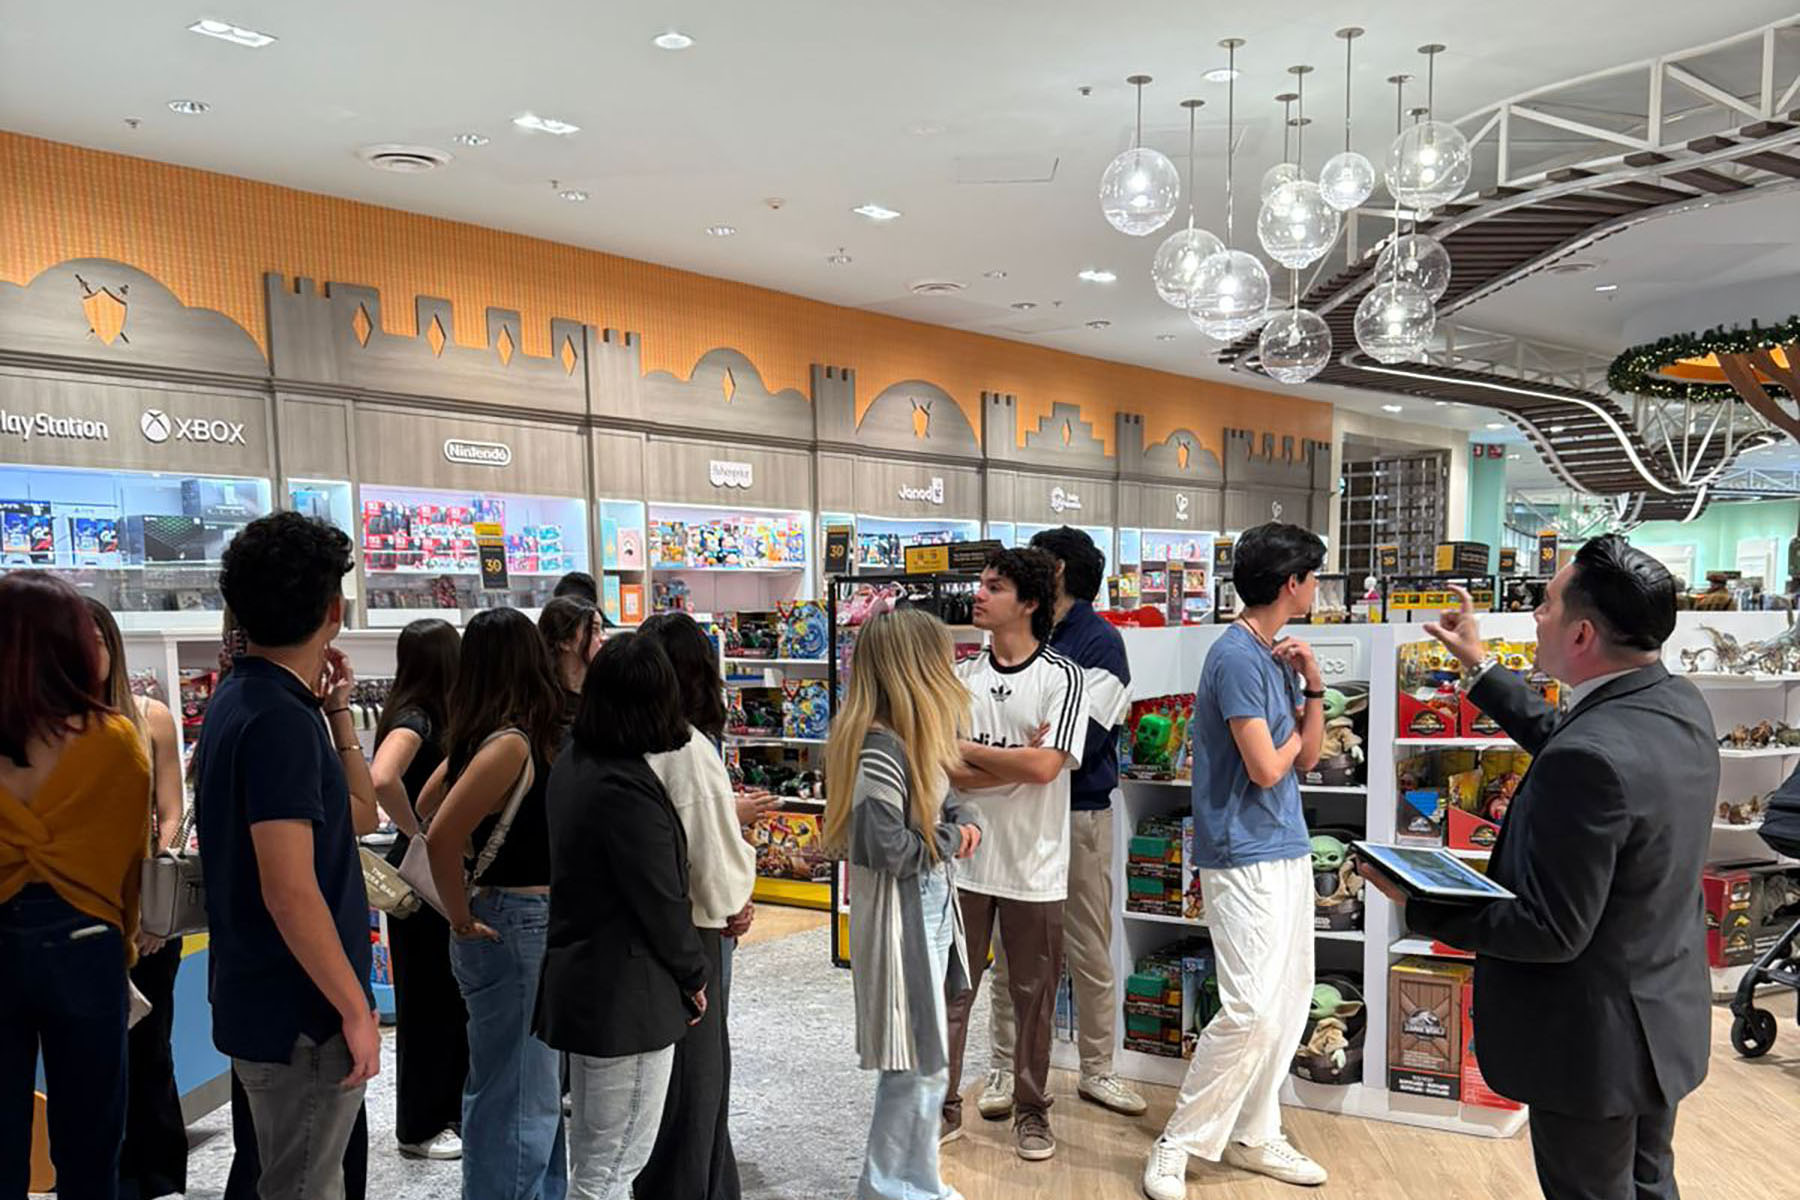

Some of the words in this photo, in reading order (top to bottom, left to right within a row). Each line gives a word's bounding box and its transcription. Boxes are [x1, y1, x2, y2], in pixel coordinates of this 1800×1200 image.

[0, 410, 108, 440] layStation
[175, 417, 246, 444] XBOX
[449, 443, 506, 461] Nintendo
[830, 545, 845, 558] 30
[484, 558, 502, 573] 30
